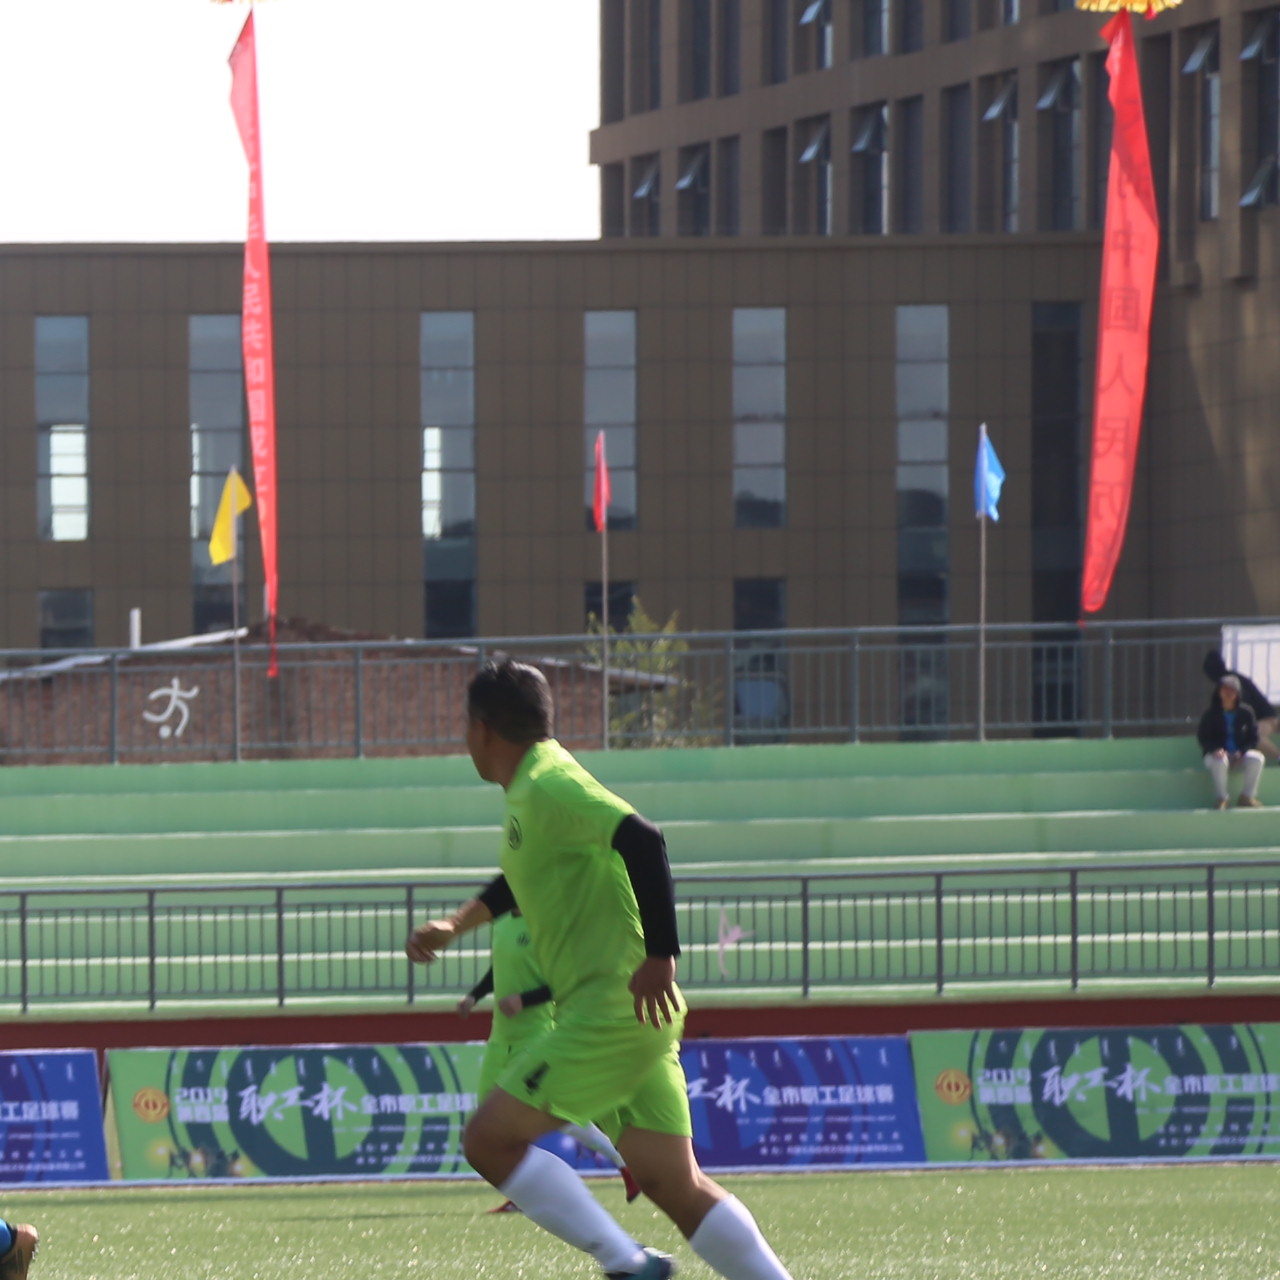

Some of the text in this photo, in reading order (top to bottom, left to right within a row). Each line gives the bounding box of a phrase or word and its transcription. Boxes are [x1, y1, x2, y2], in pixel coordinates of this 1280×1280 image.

[977, 1068, 1031, 1086] 2019
[1040, 1063, 1162, 1107] 职工杯
[174, 1087, 229, 1104] 2019
[238, 1082, 358, 1126] 职工杯
[360, 1092, 478, 1115] 全市职工足球
[687, 1074, 761, 1113] 工杯
